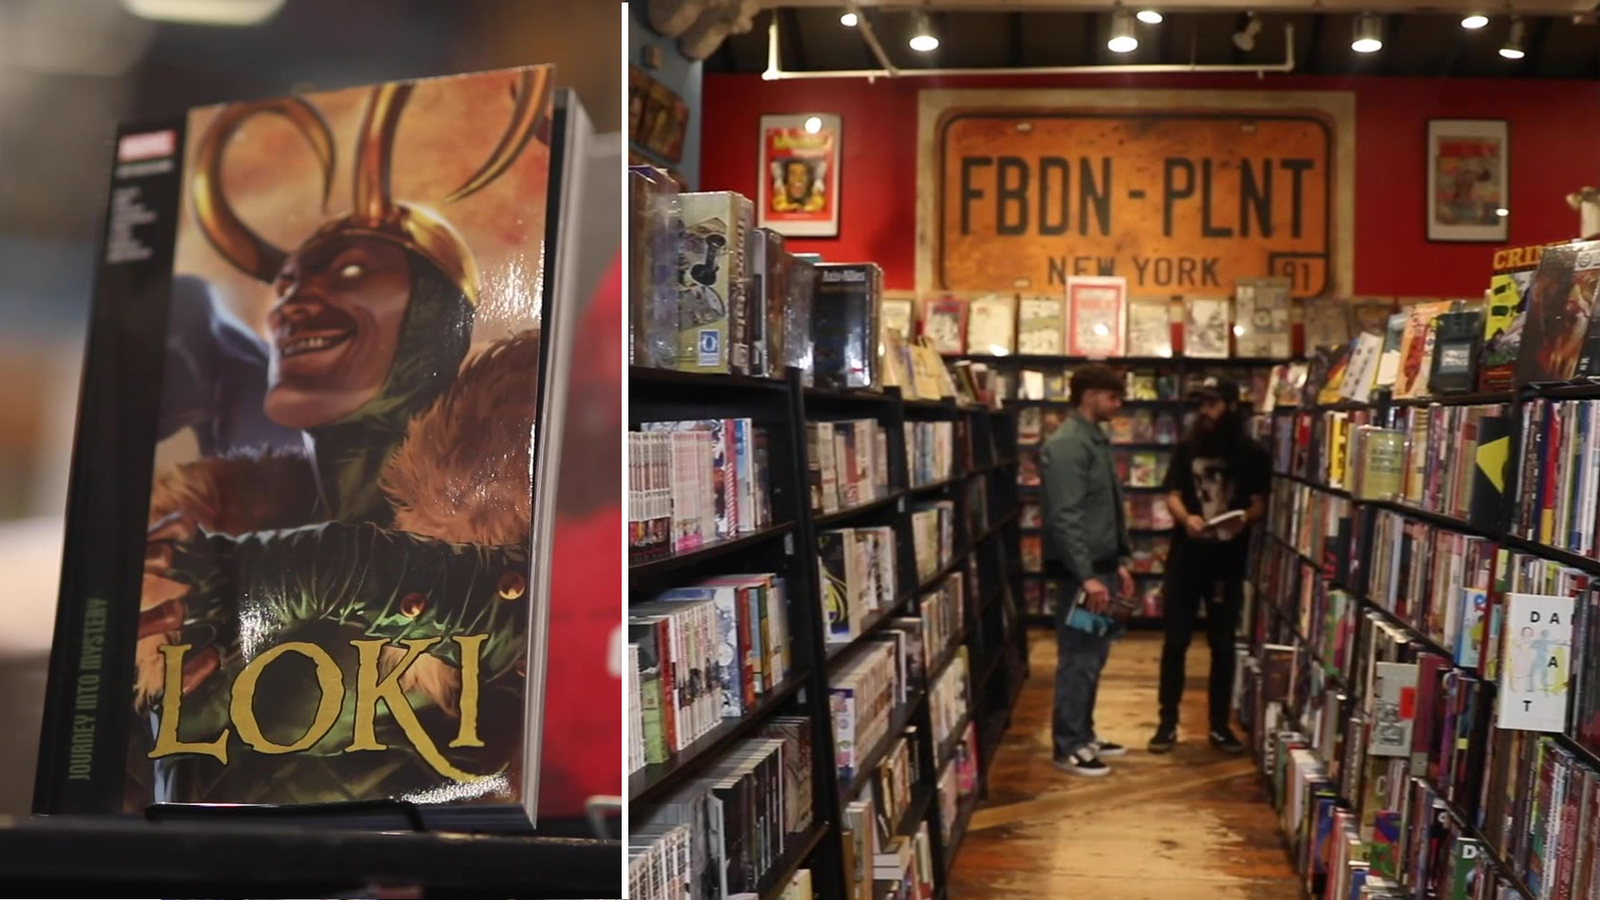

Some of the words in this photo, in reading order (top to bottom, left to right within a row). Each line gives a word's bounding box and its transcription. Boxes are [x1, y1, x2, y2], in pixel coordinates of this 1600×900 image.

[1047, 256, 1117, 285] NEW
[1133, 256, 1221, 286] YORK
[1282, 262, 1311, 290] 91
[79, 599, 108, 670] MYSTERY
[75, 674, 101, 710] INTO
[148, 633, 509, 784] LOKI
[68, 714, 96, 780] JOURNEY
